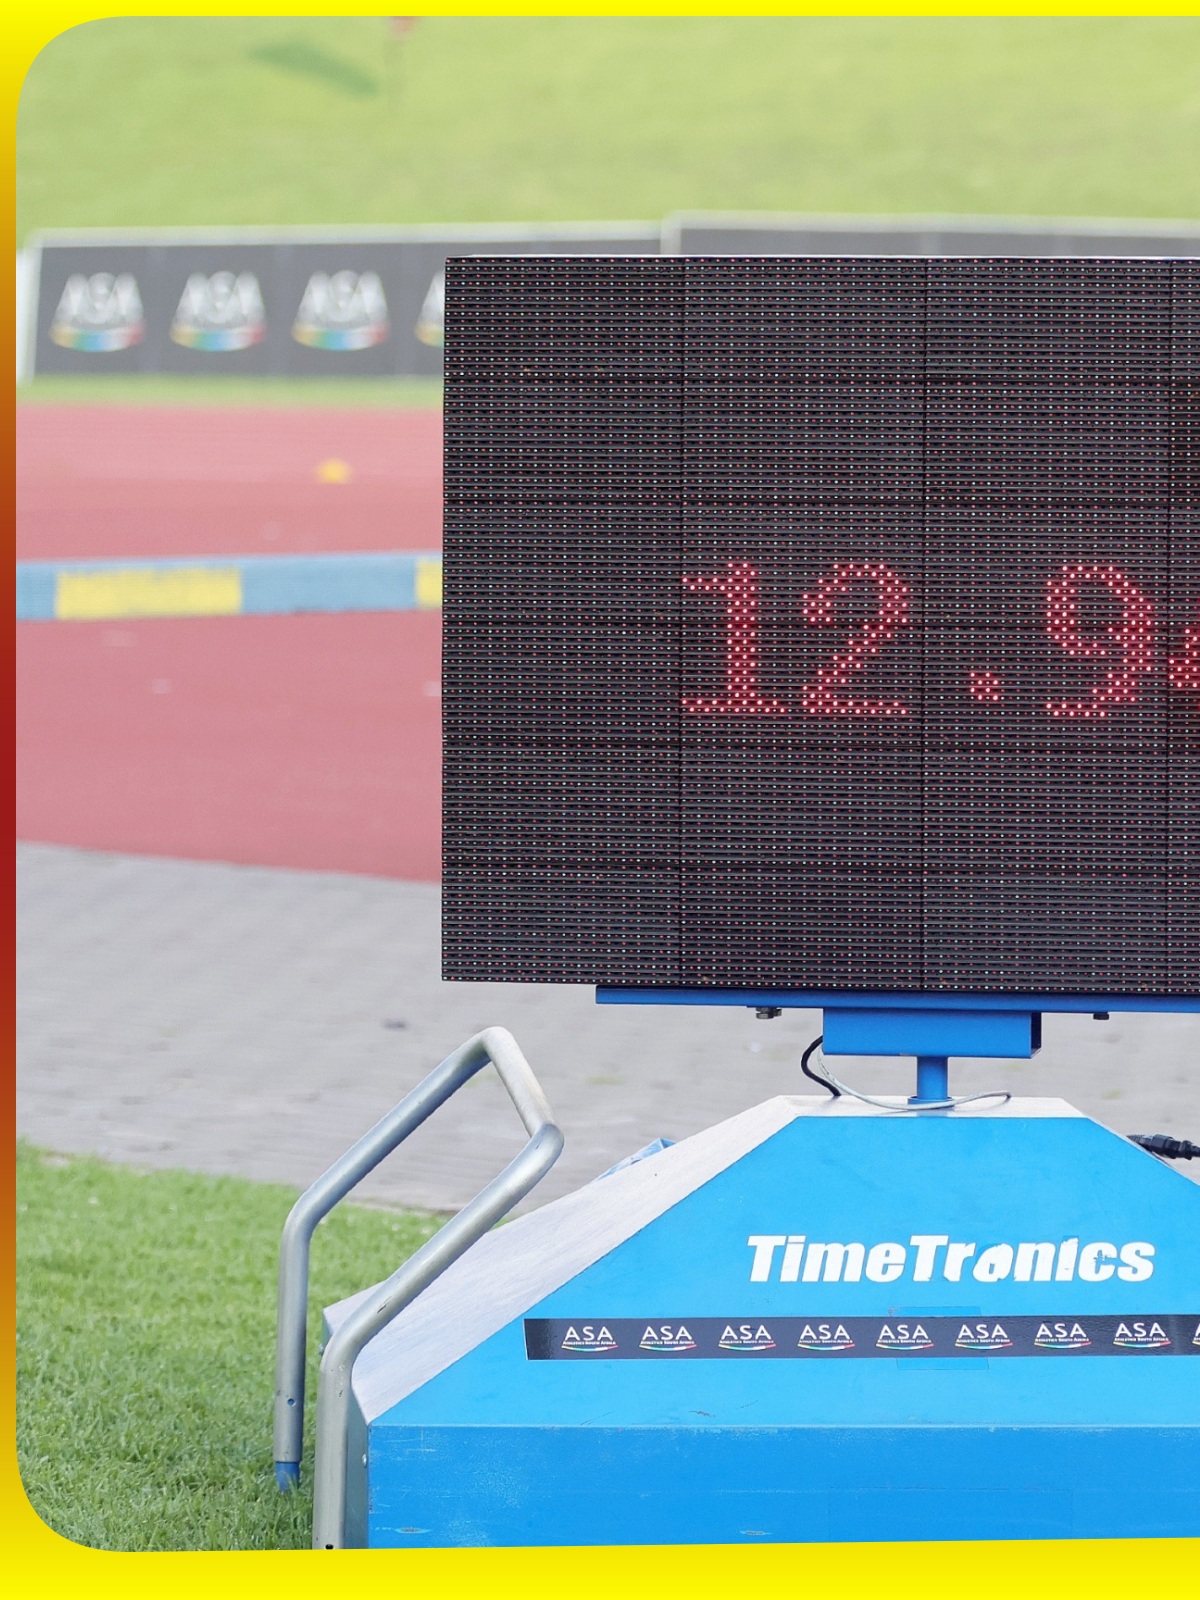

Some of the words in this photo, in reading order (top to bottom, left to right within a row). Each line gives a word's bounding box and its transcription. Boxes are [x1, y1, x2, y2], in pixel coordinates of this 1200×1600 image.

[747, 1235, 1156, 1283] TimeTronics
[564, 1326, 613, 1340] ASA
[641, 1325, 693, 1340] ASA
[721, 1325, 772, 1340] ASA
[800, 1324, 851, 1340] ASA
[879, 1324, 929, 1340] ASA
[957, 1324, 1008, 1339] ASA
[1036, 1323, 1087, 1338] ASA
[1115, 1322, 1166, 1337] ASA
